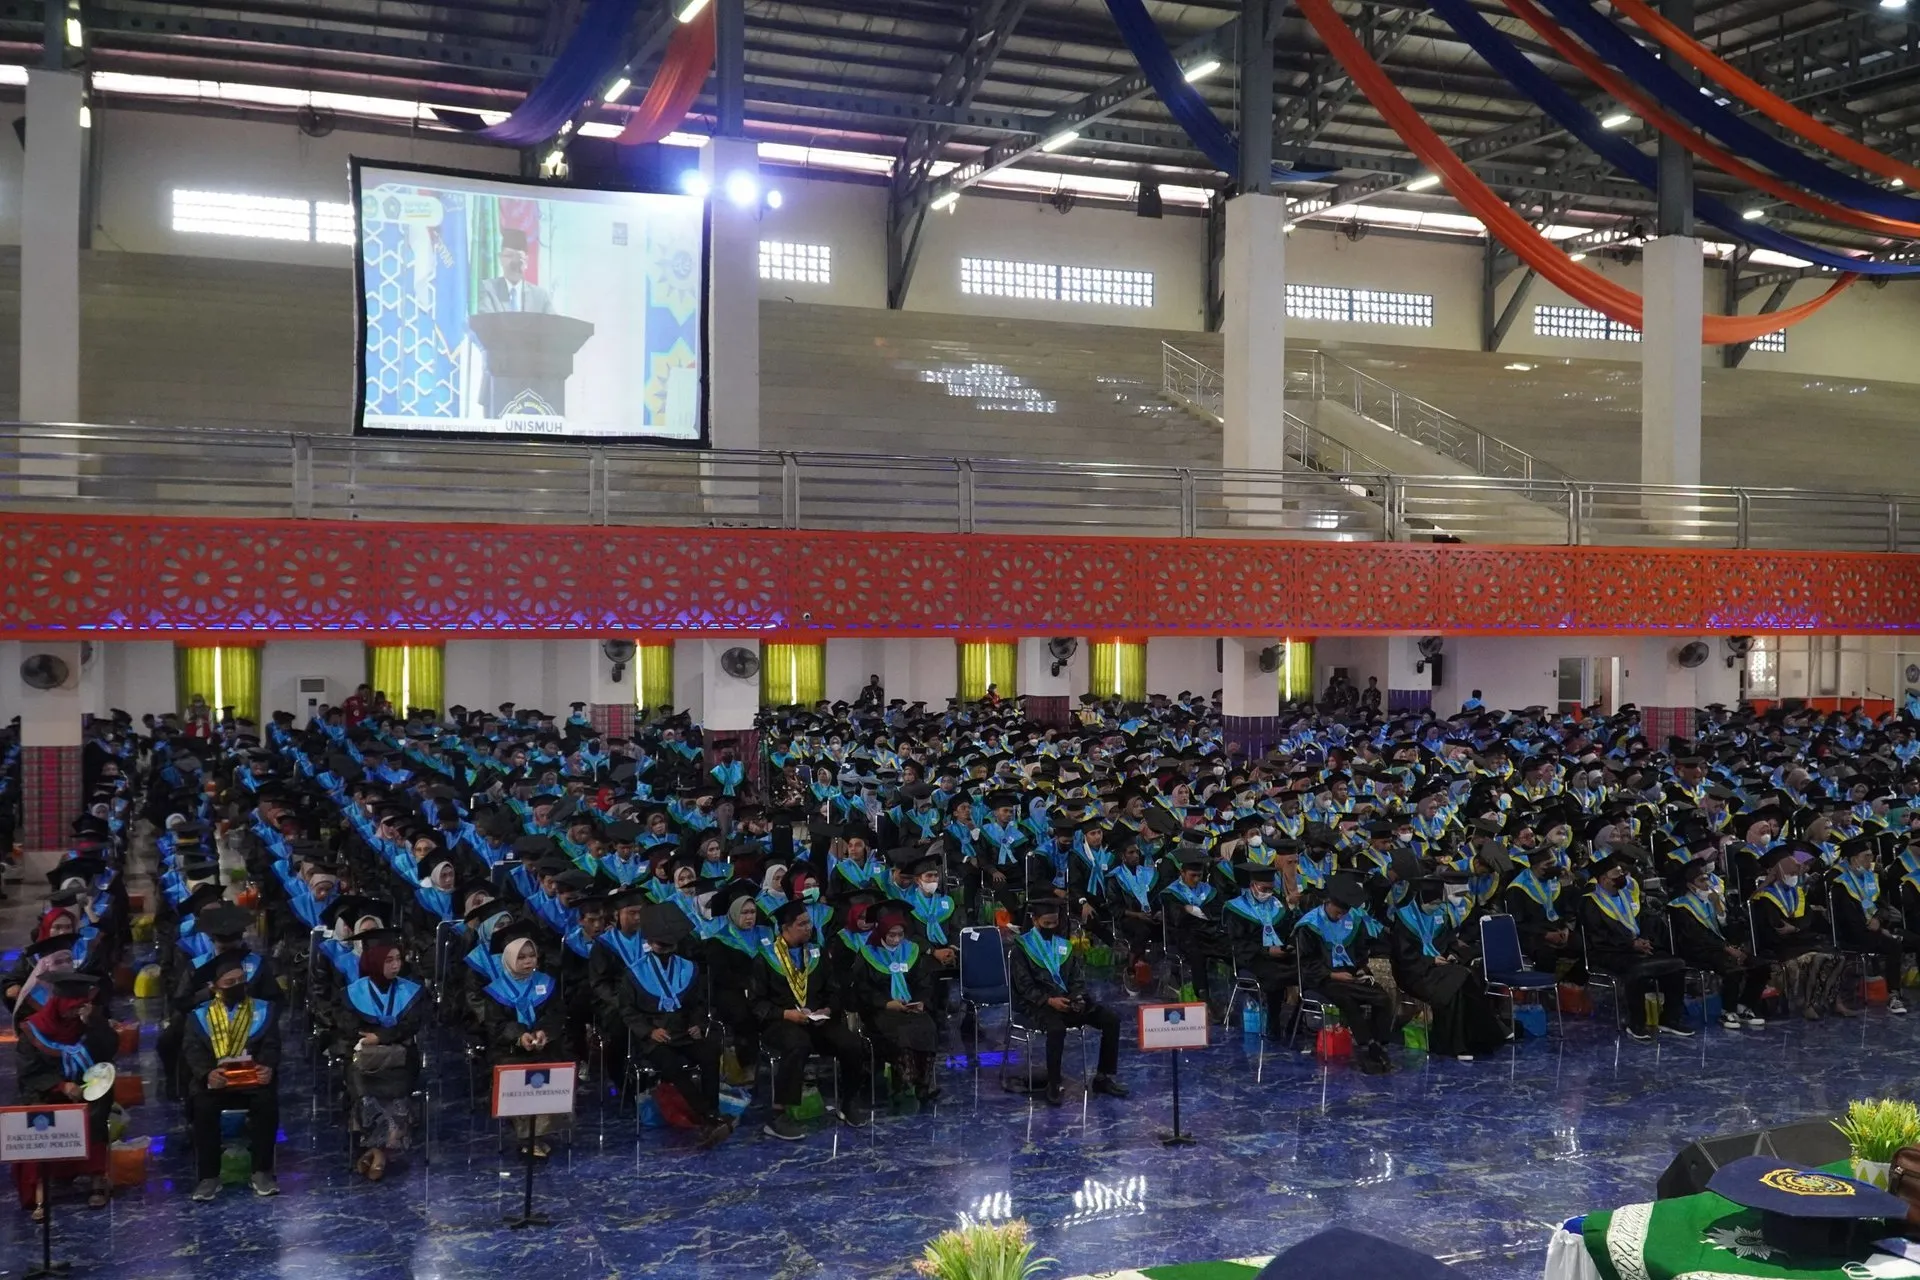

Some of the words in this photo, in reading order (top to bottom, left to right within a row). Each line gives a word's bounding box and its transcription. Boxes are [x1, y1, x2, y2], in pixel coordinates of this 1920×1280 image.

[505, 420, 562, 433] UNISMUH
[6, 1133, 49, 1142] FAKULTAS
[51, 1132, 80, 1140] SOSIAL
[6, 1143, 24, 1151] DAN
[26, 1142, 46, 1150] ILMU
[49, 1140, 82, 1149] POLITIK
